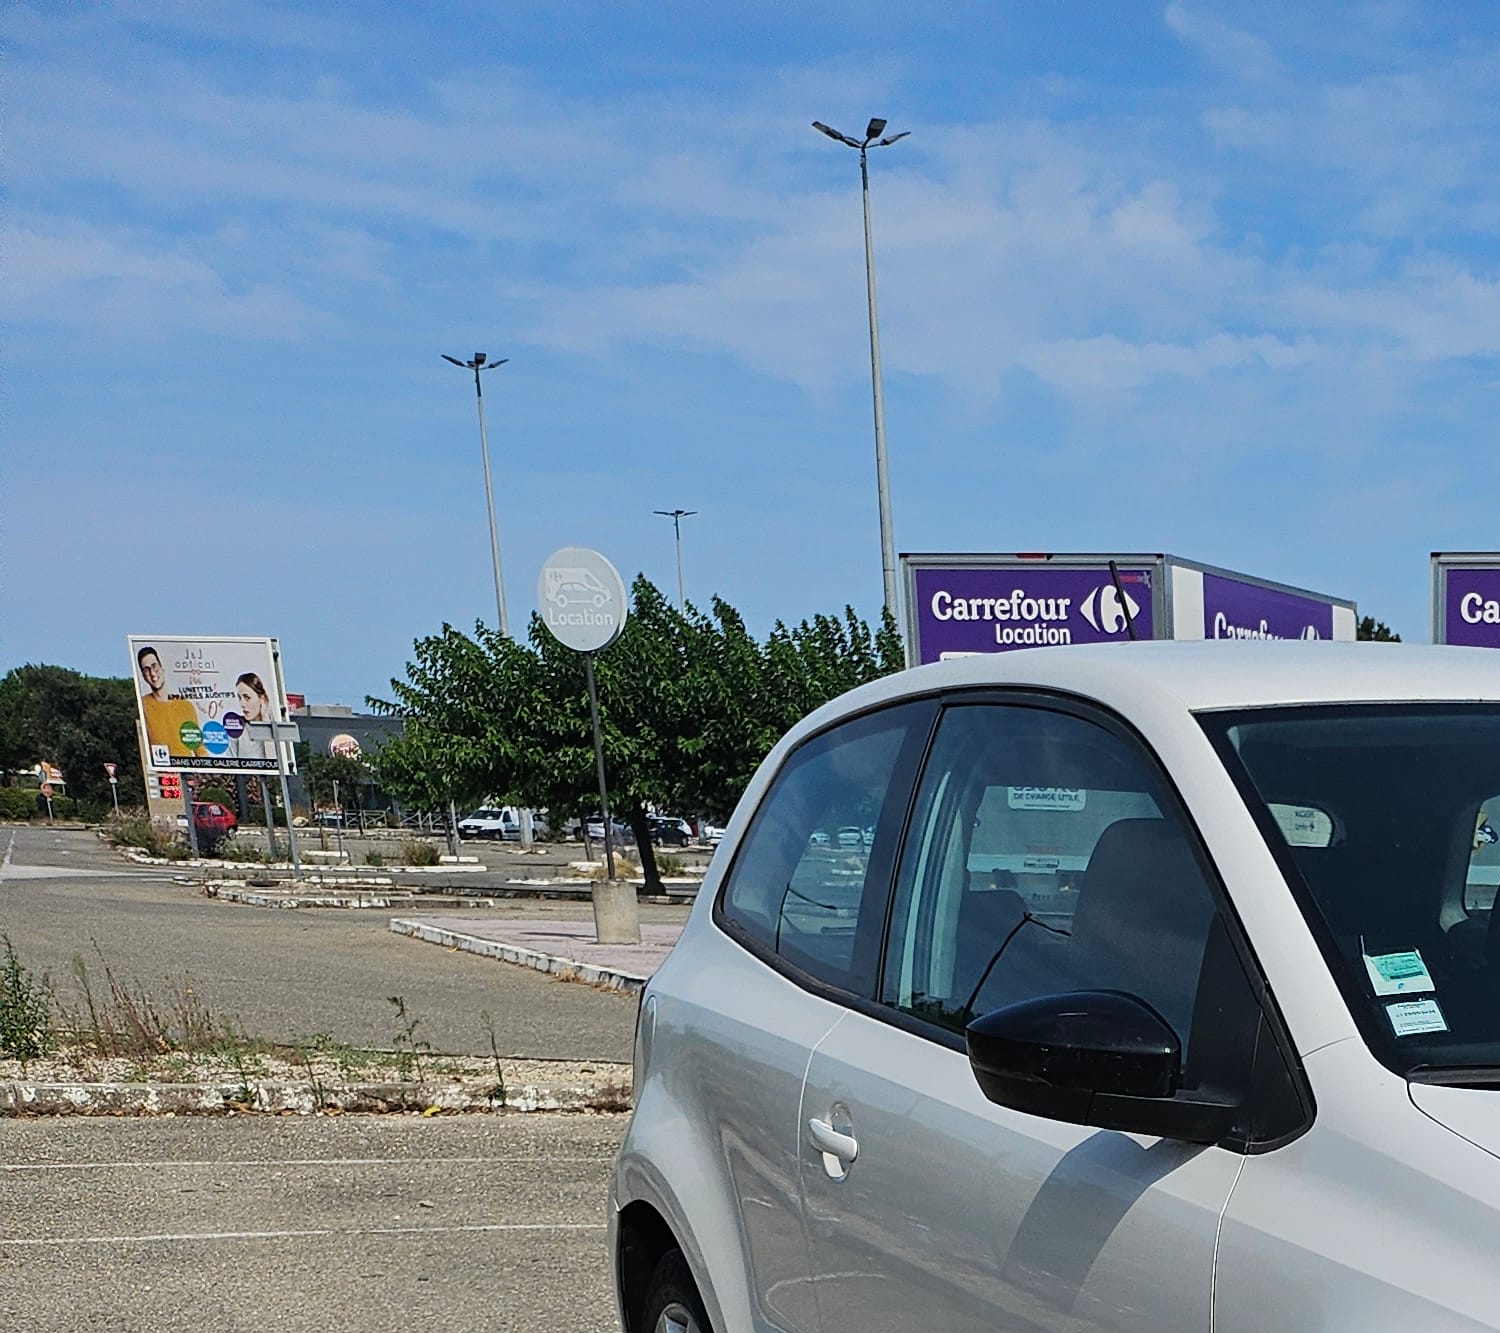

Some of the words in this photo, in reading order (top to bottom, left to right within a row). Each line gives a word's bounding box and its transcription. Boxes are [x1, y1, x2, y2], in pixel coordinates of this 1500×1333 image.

[931, 589, 1071, 621] Carrefour
[548, 607, 613, 626] Location
[995, 623, 1071, 645] location
[174, 660, 216, 669] optical
[191, 759, 213, 767] VOTRE
[213, 759, 240, 768] GALERIE
